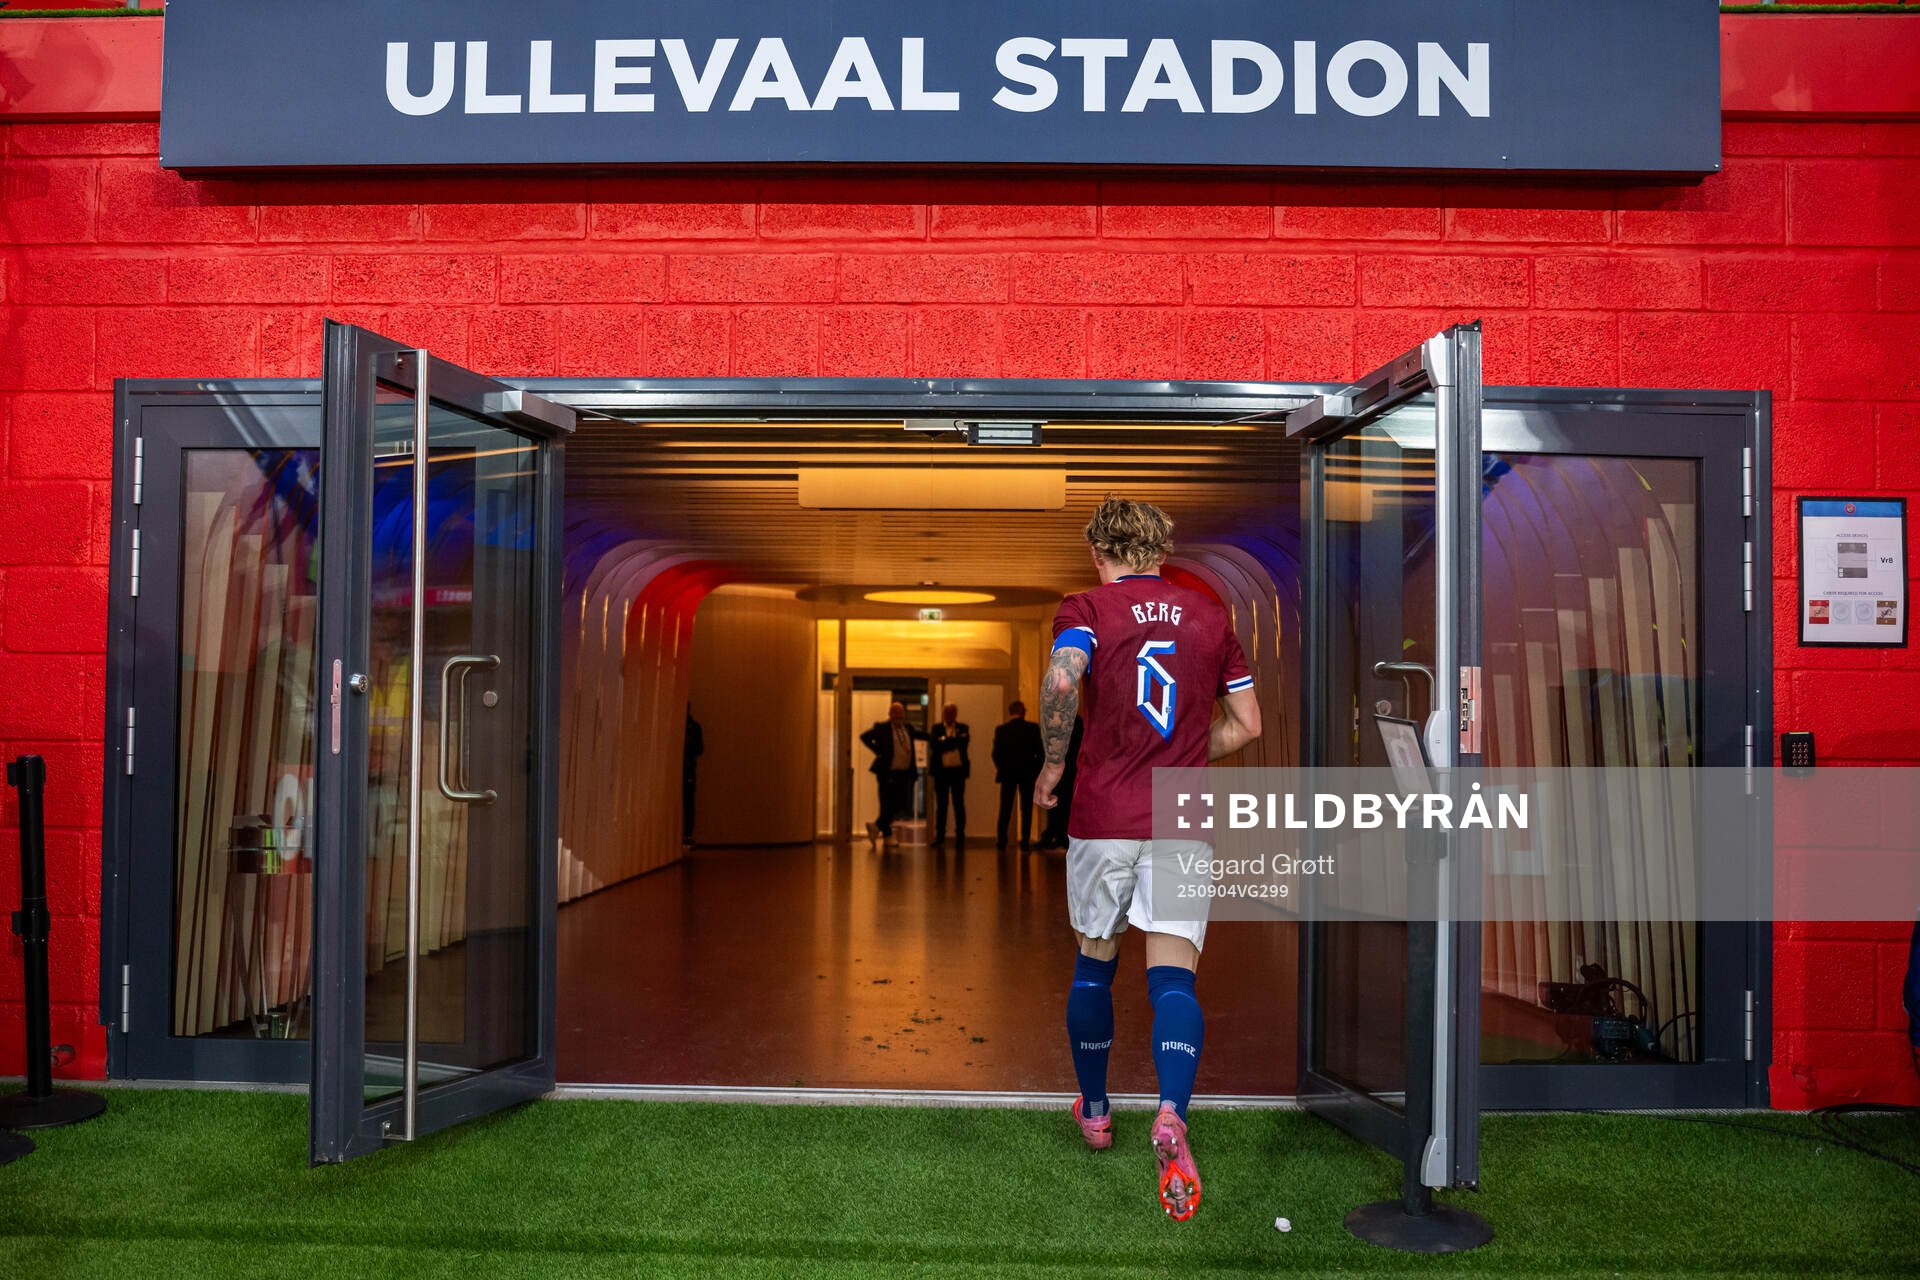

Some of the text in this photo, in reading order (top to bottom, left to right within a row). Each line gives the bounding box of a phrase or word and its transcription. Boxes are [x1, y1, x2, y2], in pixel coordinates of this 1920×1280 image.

[386, 36, 1490, 118] ULLEVAAL STADION
[1131, 601, 1182, 626] BERG
[1136, 640, 1176, 743] 6
[1162, 1040, 1197, 1057] NORGE
